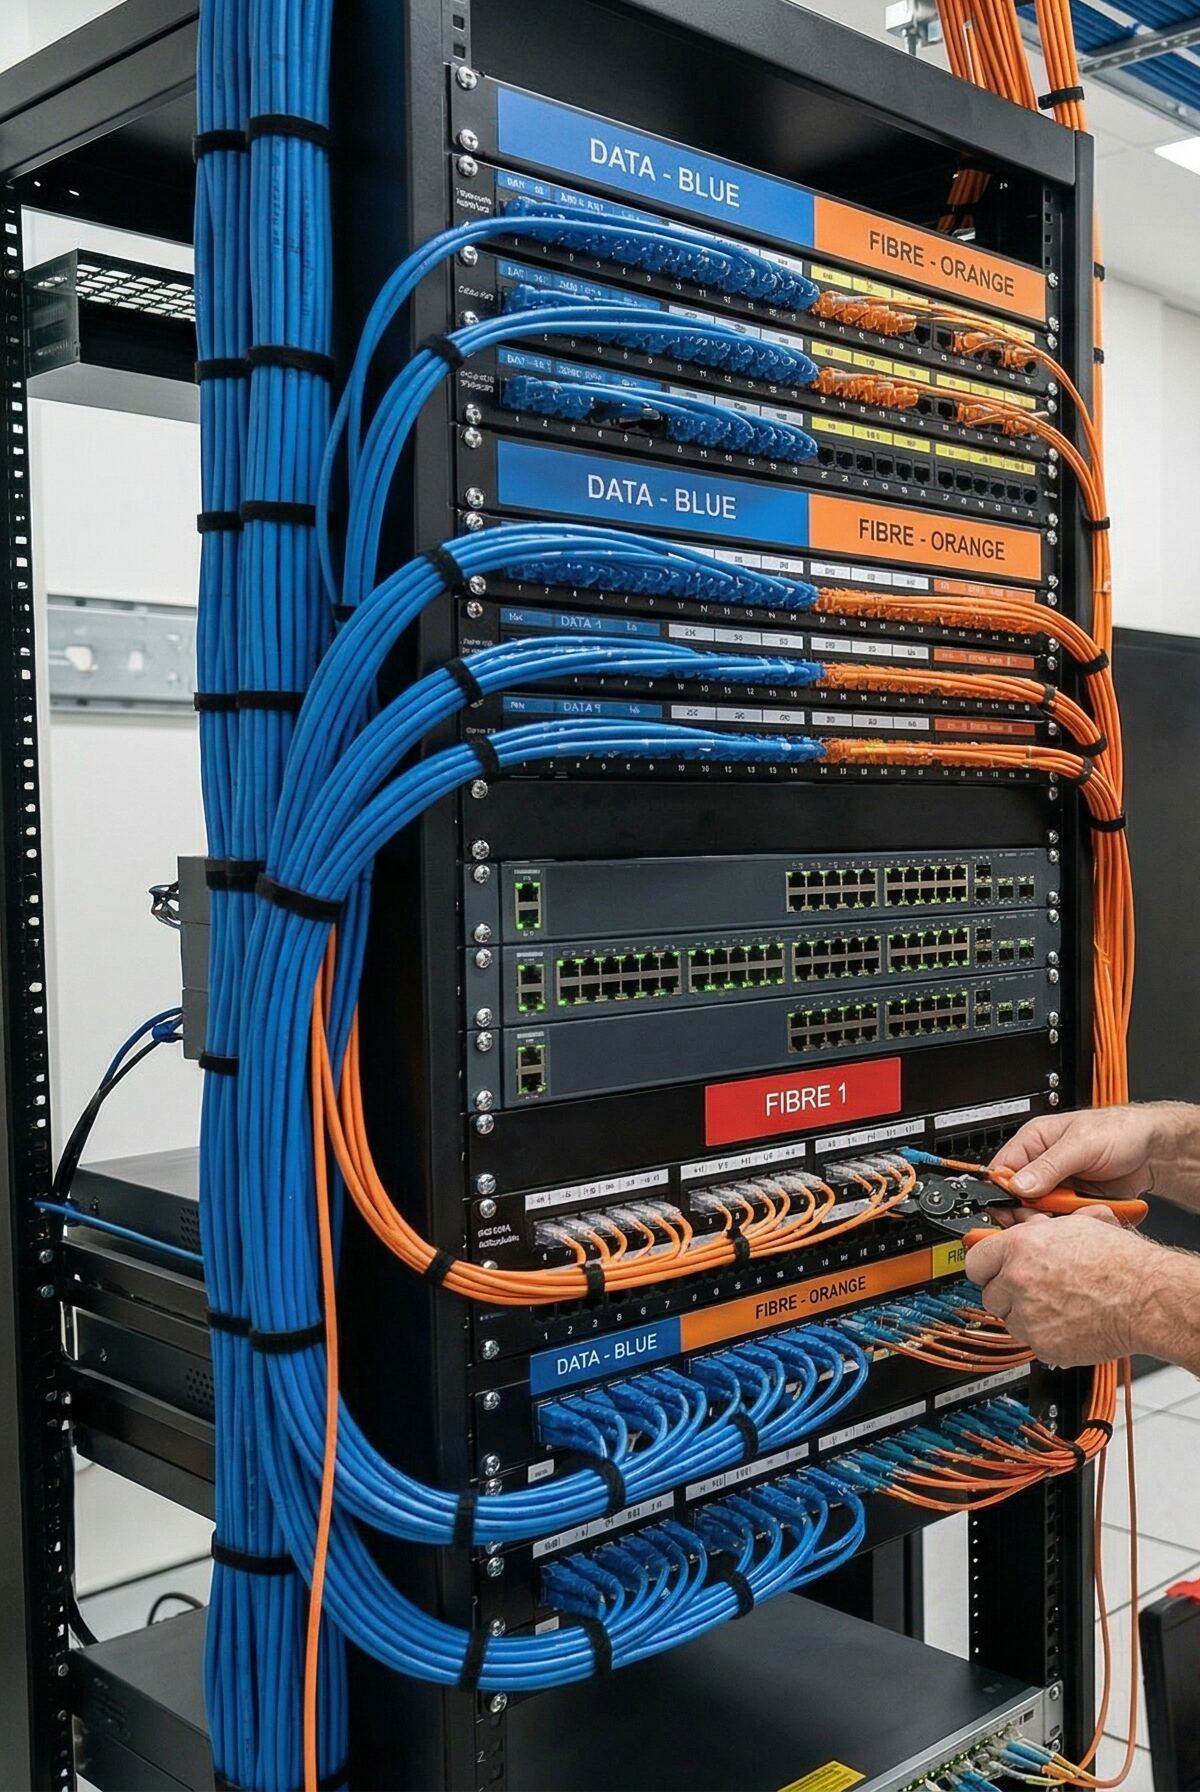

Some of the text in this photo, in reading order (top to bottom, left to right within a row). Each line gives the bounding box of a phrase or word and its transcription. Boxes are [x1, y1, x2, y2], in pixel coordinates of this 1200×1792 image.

[590, 138, 656, 182] DATA
[678, 167, 740, 208] BLUE
[869, 230, 925, 268] FIBRE
[940, 255, 1015, 298] ORANGE
[587, 474, 653, 508] DATA
[675, 488, 737, 520] BLUE
[858, 518, 914, 547] FIBRE
[930, 531, 1006, 562] ORANGE
[561, 615, 592, 629] DATA
[563, 702, 593, 714] DATA
[766, 1081, 847, 1117] FIBRE 1
[755, 1294, 798, 1320] FIBRE
[809, 1276, 867, 1304] ORANGE
[556, 1350, 600, 1375] DATA
[614, 1333, 658, 1360] BLUE
